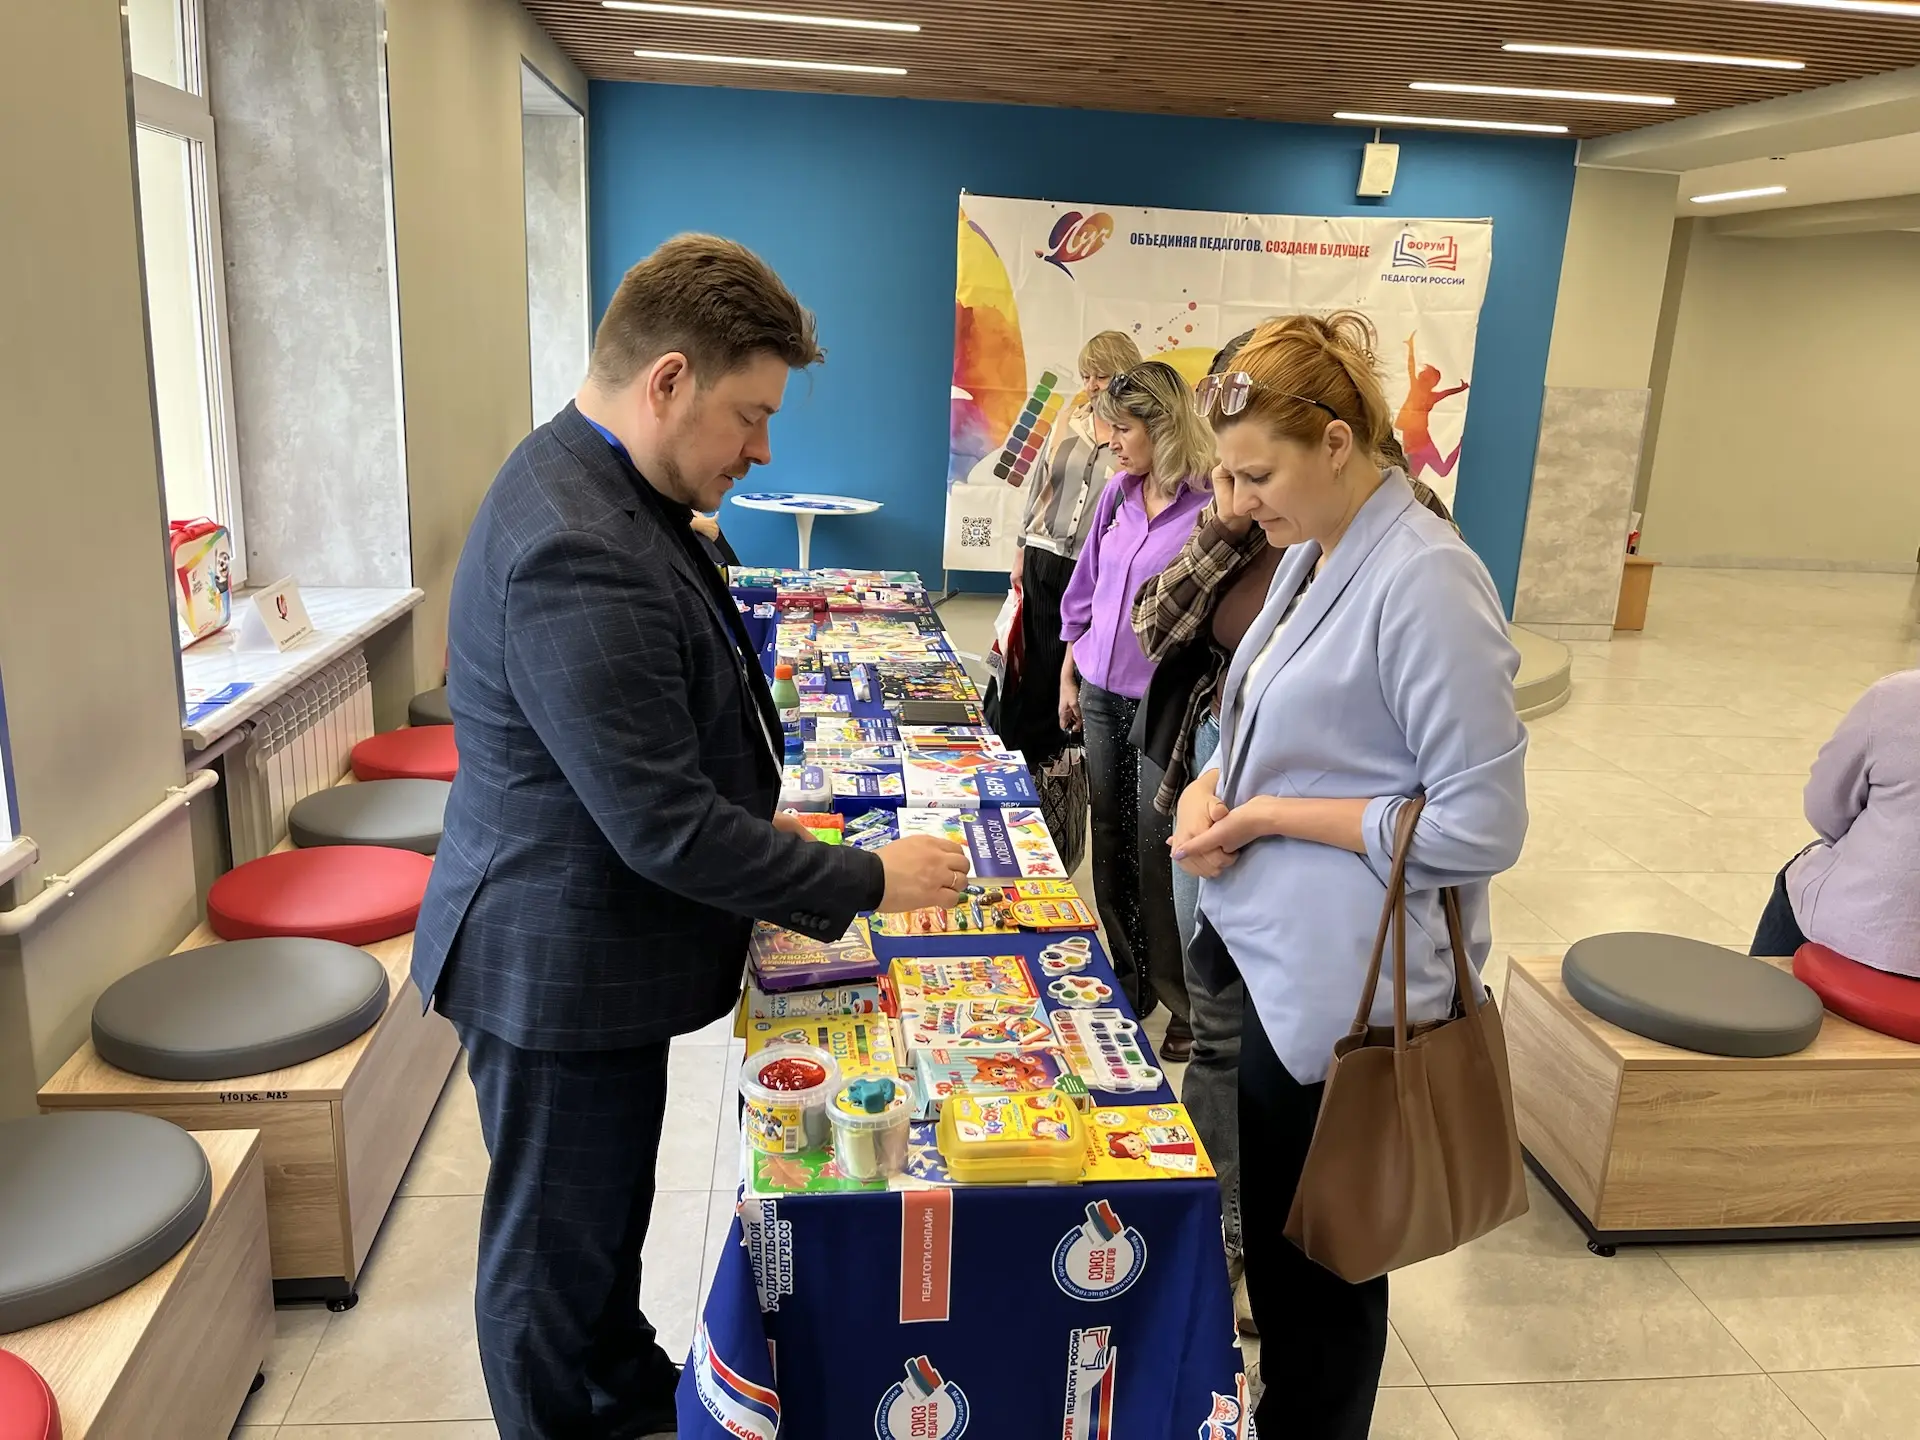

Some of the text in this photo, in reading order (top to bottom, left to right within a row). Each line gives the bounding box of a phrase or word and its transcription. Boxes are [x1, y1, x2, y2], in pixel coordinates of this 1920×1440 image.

[1130, 232, 1370, 258] ОБЪЕДИНЯЯ ПЕДАГОГОВ, СОЗДАЕМ БУДУЩЕЕ
[1407, 240, 1445, 251] ФОРУМ
[1381, 273, 1465, 286] ПЕДАГОГИ РОССИИ
[985, 776, 1007, 796] ЭБРУ
[747, 1221, 764, 1288] БОЛЬШОЙ
[760, 1202, 778, 1310] РОДИТЕЛЬСКИЙ
[779, 1221, 791, 1293] КОНГРЕСС
[921, 1208, 934, 1303] ПЕДАГОГИ.ОНЛАЙН
[1088, 1250, 1105, 1280] СОЮЗ
[1104, 1247, 1117, 1284] ПЕДАГОГОВ
[1065, 1329, 1081, 1440] ОРУМ ПЕДАГОГИ РОССИИ
[911, 1405, 927, 1437] СОЮЗ
[927, 1402, 938, 1439] ПЕДАГОГОВ
